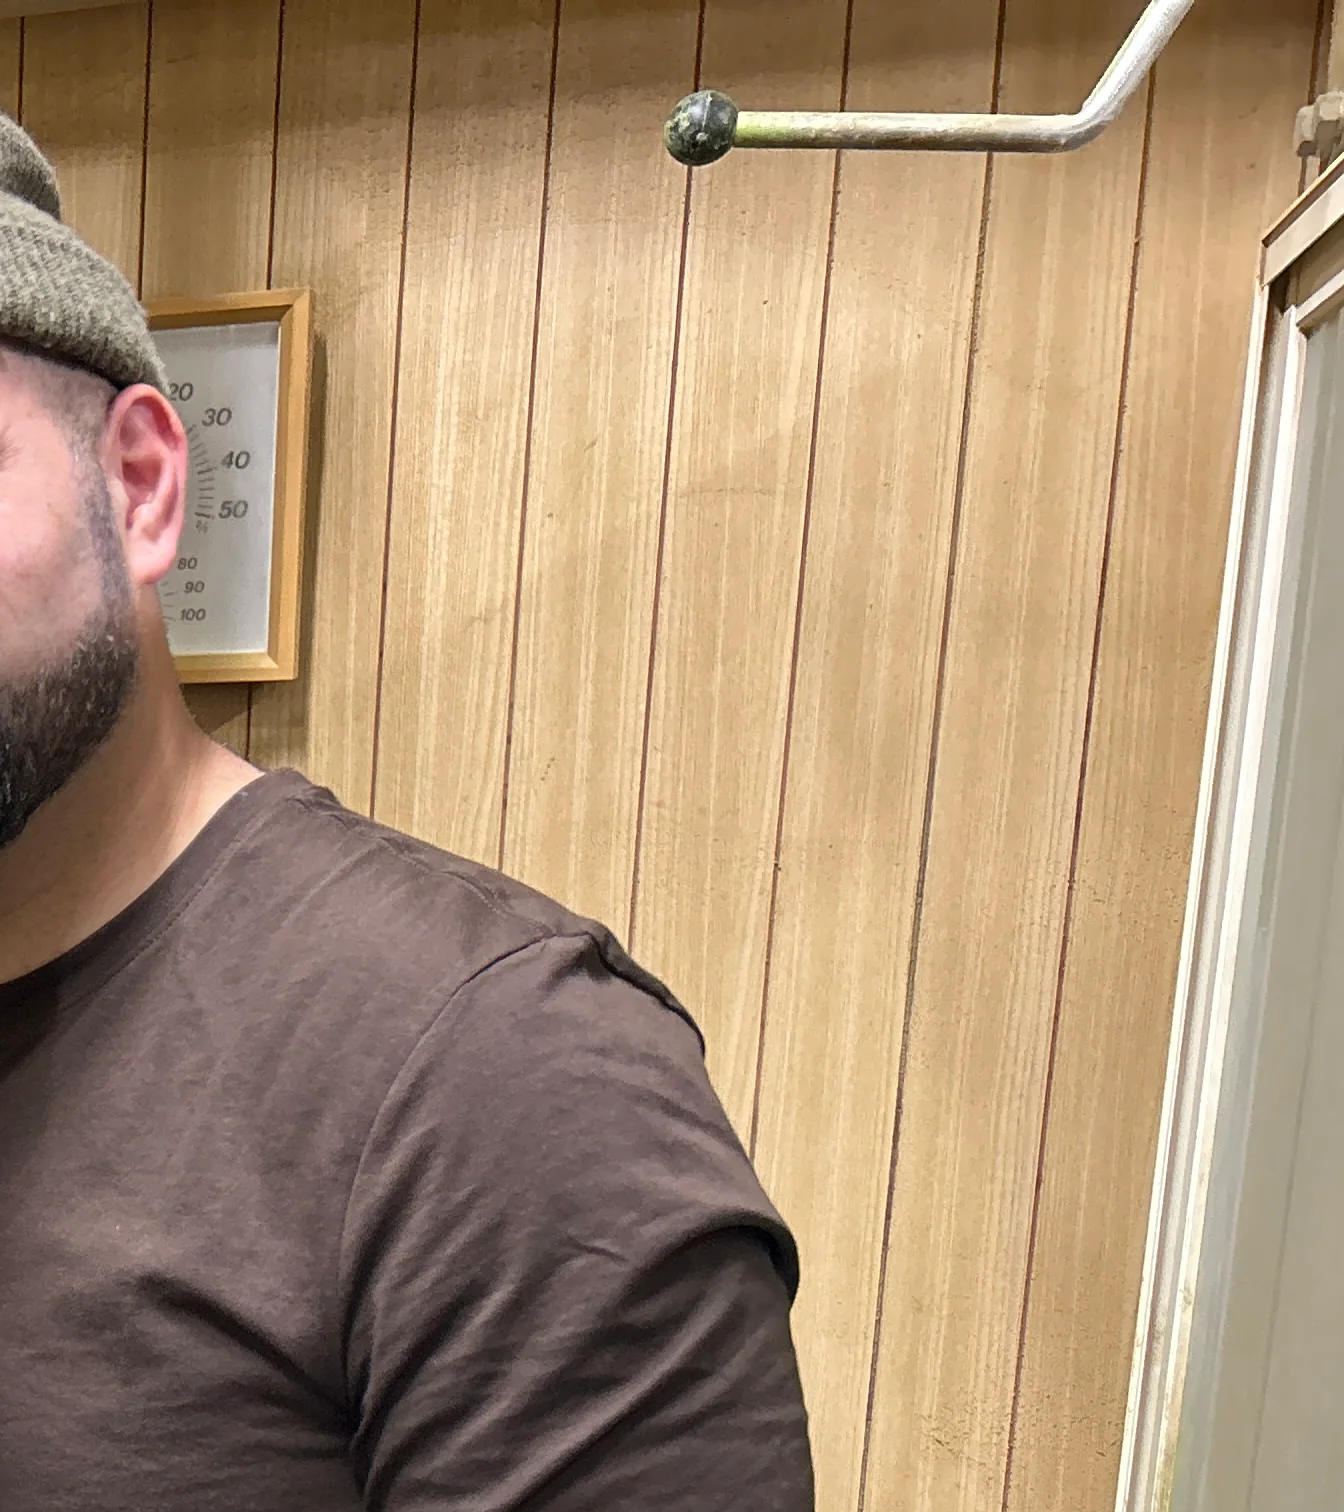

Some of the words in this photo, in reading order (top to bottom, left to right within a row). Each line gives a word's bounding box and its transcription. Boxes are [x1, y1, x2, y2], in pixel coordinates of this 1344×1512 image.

[169, 382, 194, 402] 20
[201, 407, 233, 427] 30
[221, 450, 251, 470] 40
[218, 500, 249, 519] 50
[177, 557, 198, 570] 80
[183, 581, 205, 594] 90
[180, 608, 207, 621] 100
